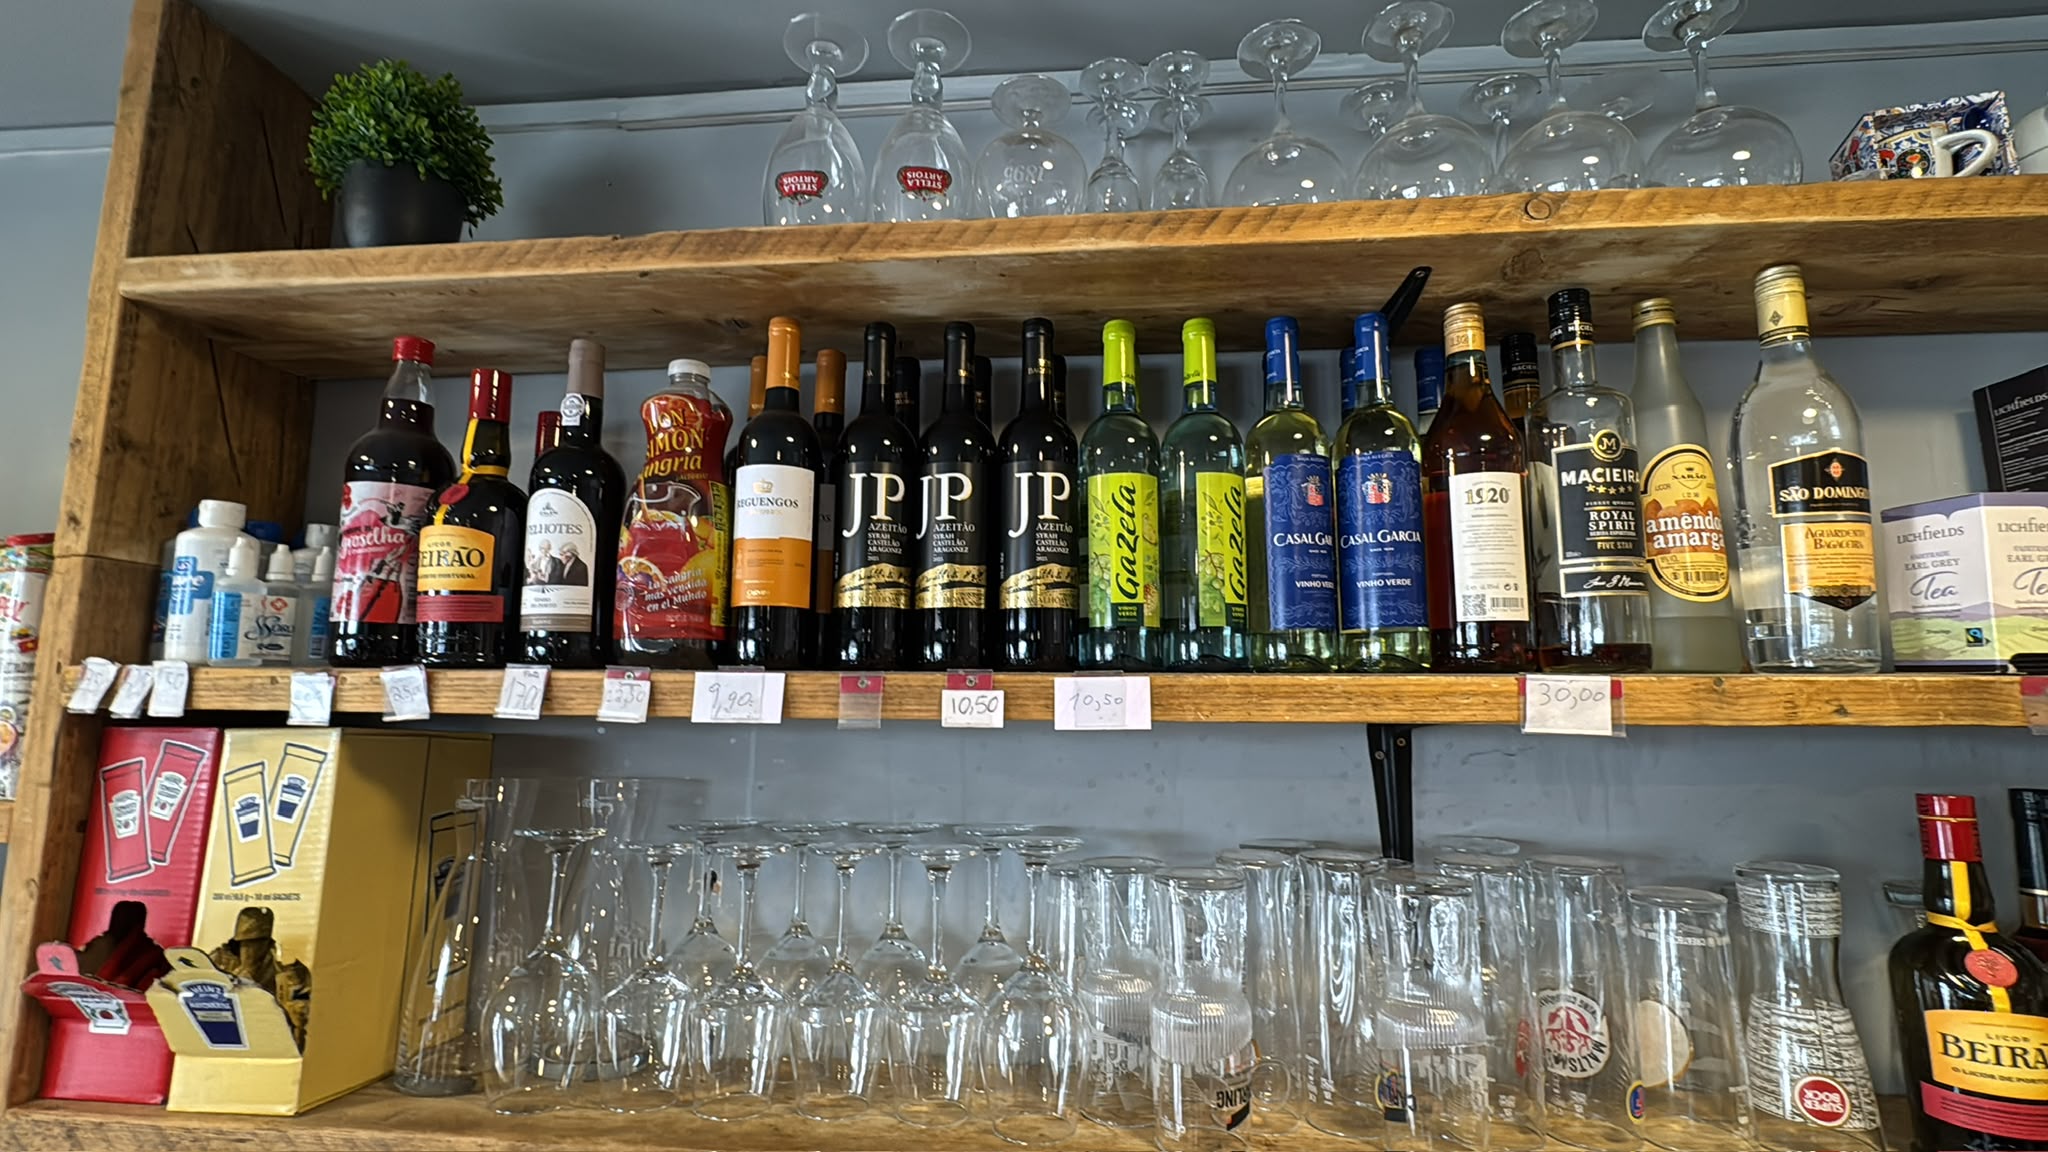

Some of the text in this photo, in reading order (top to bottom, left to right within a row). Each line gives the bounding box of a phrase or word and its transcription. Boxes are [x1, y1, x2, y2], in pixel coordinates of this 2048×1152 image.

[783, 176, 819, 184] ARTOIS
[906, 172, 943, 182] ARTOIS
[908, 179, 942, 189] STELLA
[783, 183, 818, 192] STELLA
[647, 428, 704, 458] IMON
[1464, 487, 1511, 505] 1920
[1779, 485, 1870, 502] SÃO DOMING
[842, 472, 905, 538] JP
[916, 472, 973, 538] JP
[1008, 472, 1071, 538] JP
[1589, 510, 1635, 520] ROYAL
[1646, 510, 1724, 533] amêndo
[528, 523, 584, 536] ELHOTES
[868, 522, 908, 534] AZEITÃO
[933, 522, 976, 532] AZEITÃO
[1036, 522, 1074, 534] AZEITÃO
[1588, 520, 1636, 531] SPIRIT
[868, 532, 890, 540] SYRAH
[933, 532, 954, 540] SYRAH
[1036, 532, 1058, 540] SYRAH
[1111, 481, 1140, 600] Gazela
[1273, 532, 1314, 547] CASAL
[1340, 530, 1422, 548] CASAL GARCIA
[419, 546, 485, 568] EIRÃO
[1904, 558, 1960, 572] EARL GREY
[2008, 555, 2034, 564] EARL
[1356, 578, 1412, 588] VINHO VERDE
[1910, 571, 1959, 600] Tea
[2013, 567, 2048, 596] Te
[646, 590, 707, 612] en el Mundo
[1070, 692, 1124, 711] 10,50
[1538, 683, 1606, 710] 30,00
[952, 696, 998, 716] 10,50
[1546, 1039, 1608, 1073] MALTSM
[1936, 1030, 2048, 1072] BEIRÃ
[1216, 1086, 1250, 1108] RLING
[1802, 1088, 1840, 1102] BOCK
[1802, 1098, 1845, 1114] SUPER
